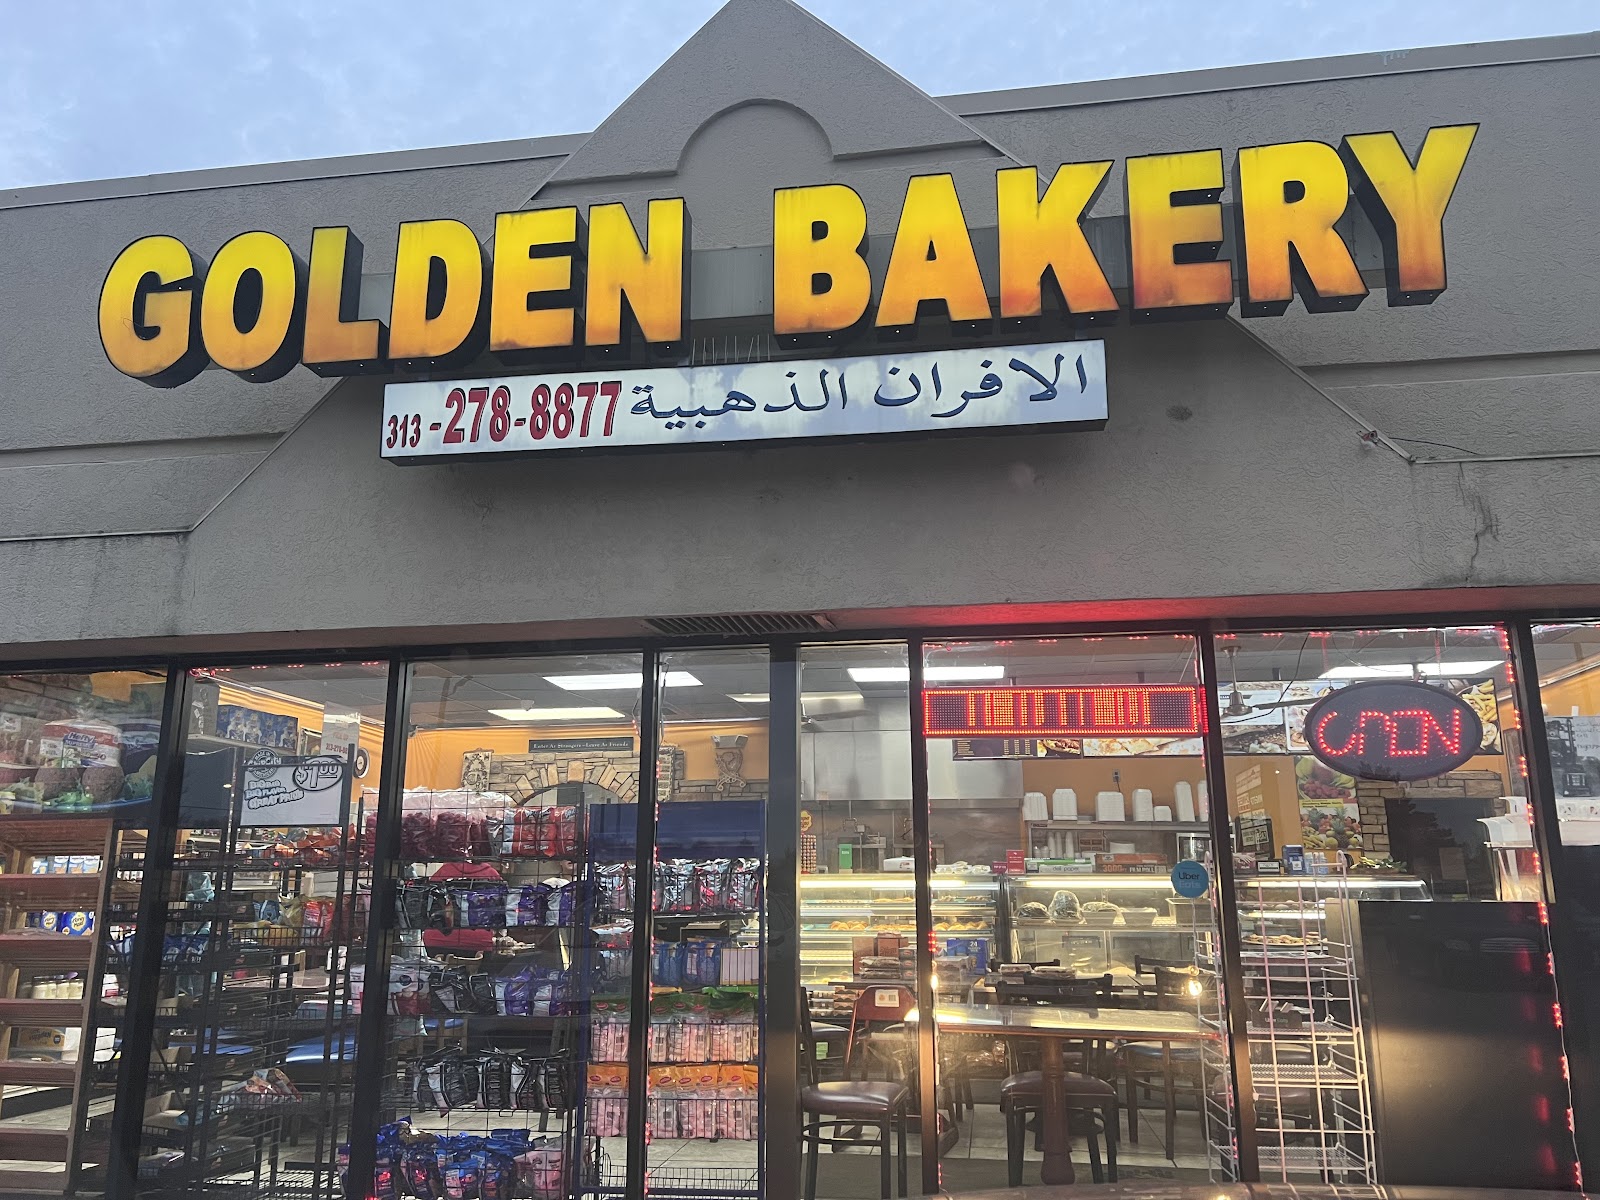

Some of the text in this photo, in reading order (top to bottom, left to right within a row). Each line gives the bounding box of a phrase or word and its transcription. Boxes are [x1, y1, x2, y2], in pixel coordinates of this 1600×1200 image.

[98, 122, 1481, 380] GOLDEN BAKERY
[630, 367, 848, 430] الذهبية
[68, 732, 96, 743] Hefty
[1178, 871, 1200, 880] Uber
